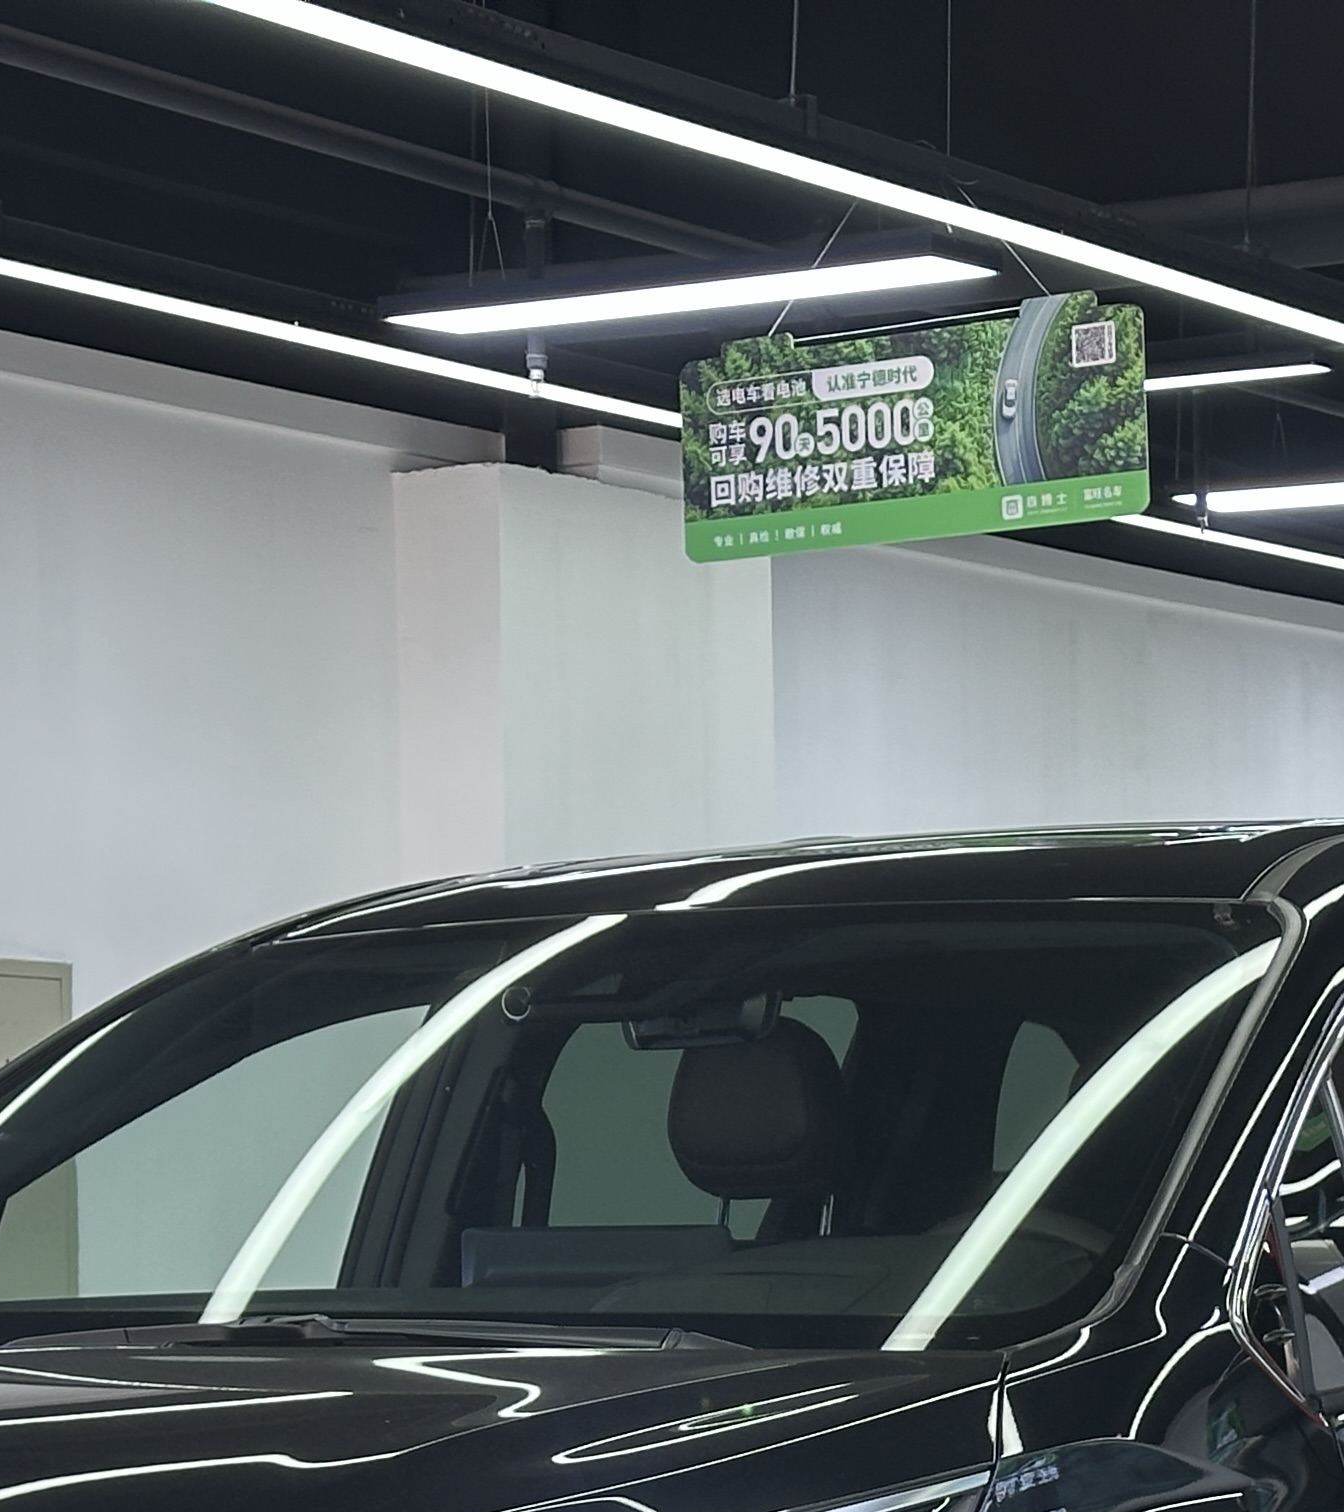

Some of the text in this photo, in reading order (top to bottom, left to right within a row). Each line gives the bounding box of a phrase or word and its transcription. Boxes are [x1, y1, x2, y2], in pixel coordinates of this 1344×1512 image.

[826, 366, 918, 392] 认准宁德时代
[709, 450, 936, 508] 回购维修双重保障
